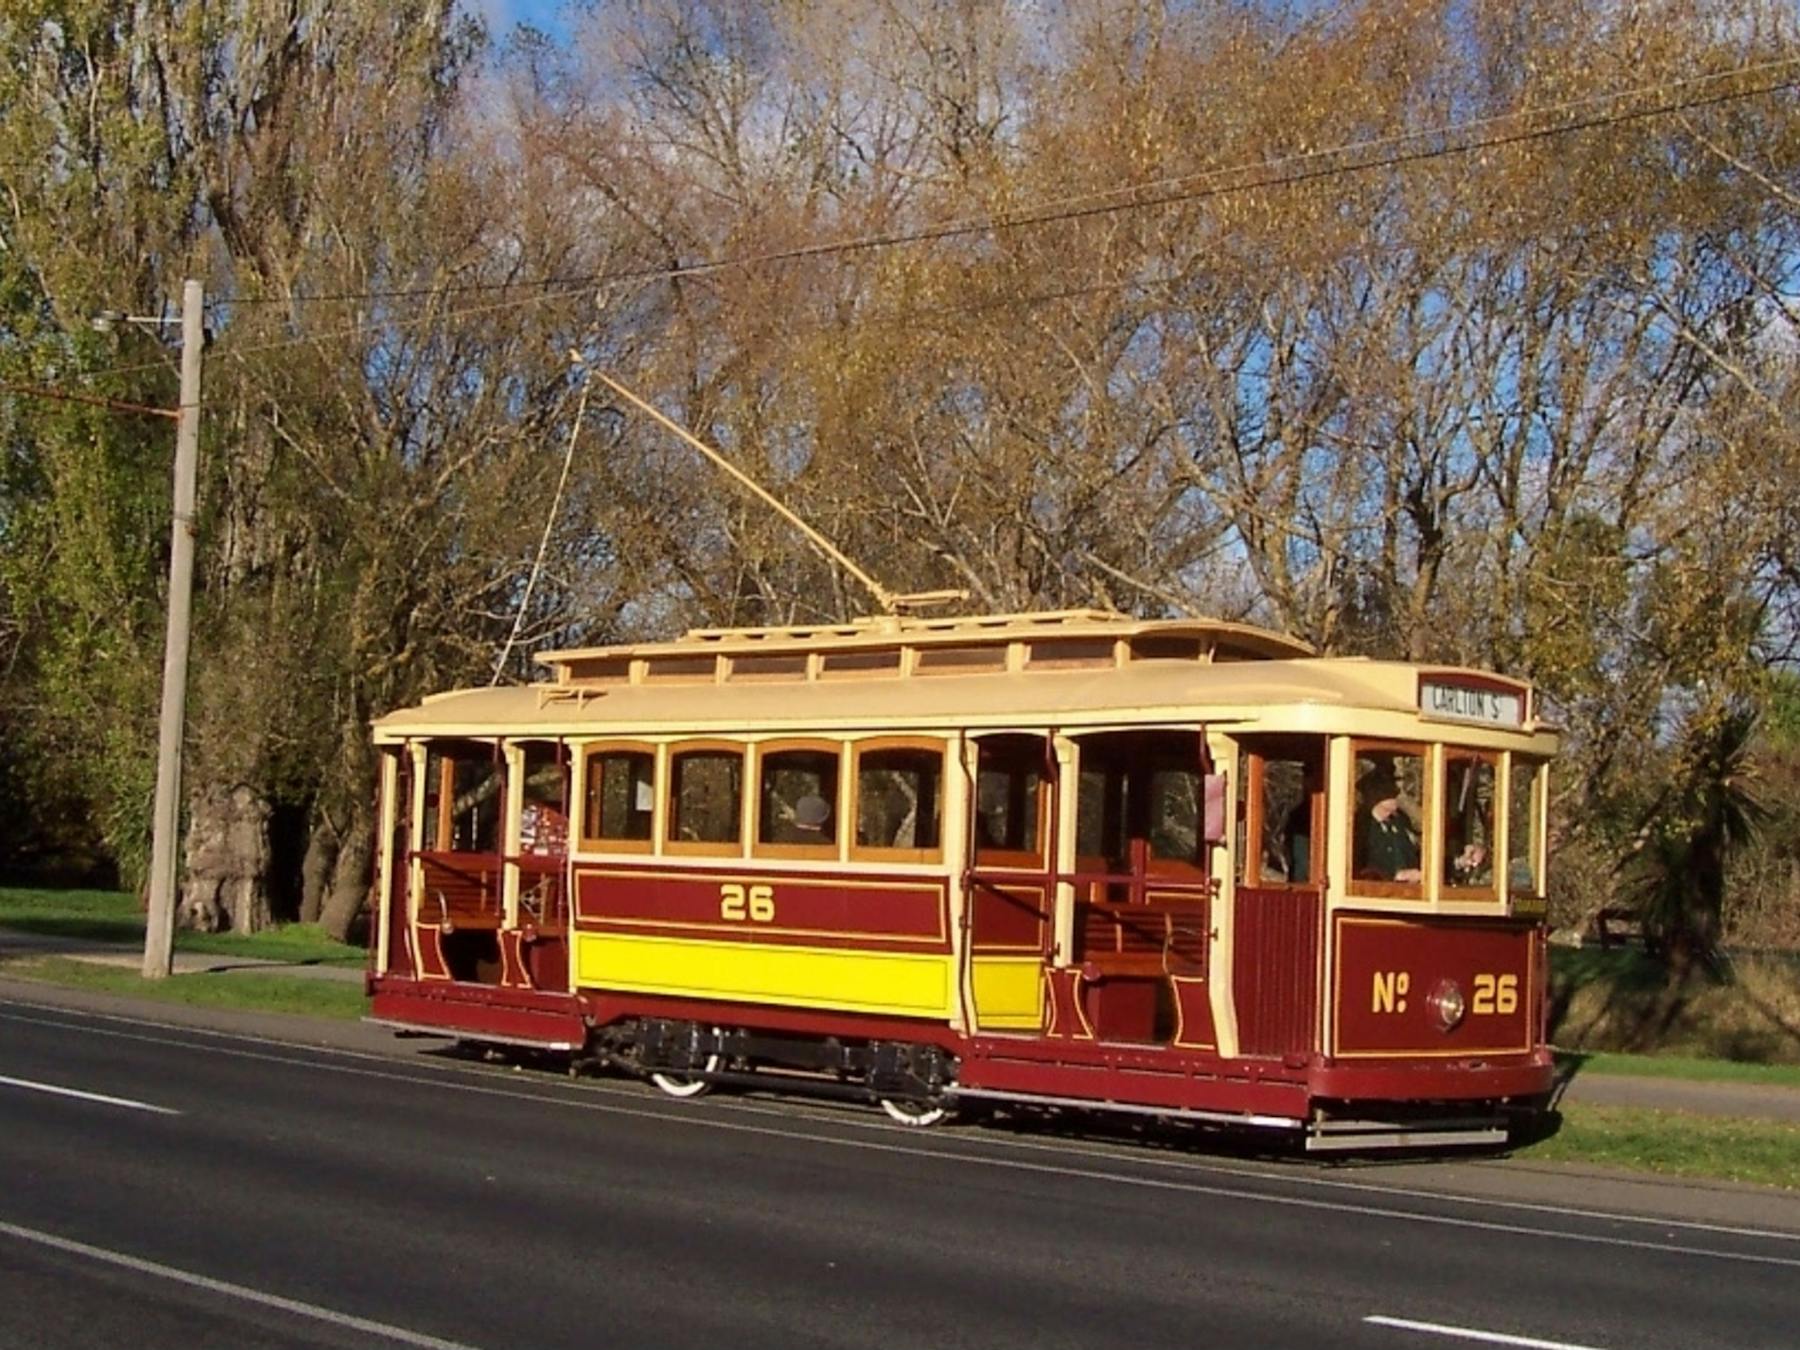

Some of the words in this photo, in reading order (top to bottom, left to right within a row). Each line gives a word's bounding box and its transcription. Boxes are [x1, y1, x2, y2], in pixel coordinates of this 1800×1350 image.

[1432, 685, 1485, 717] CARLTON
[720, 883, 775, 922] 26
[1472, 973, 1518, 1014] 26
